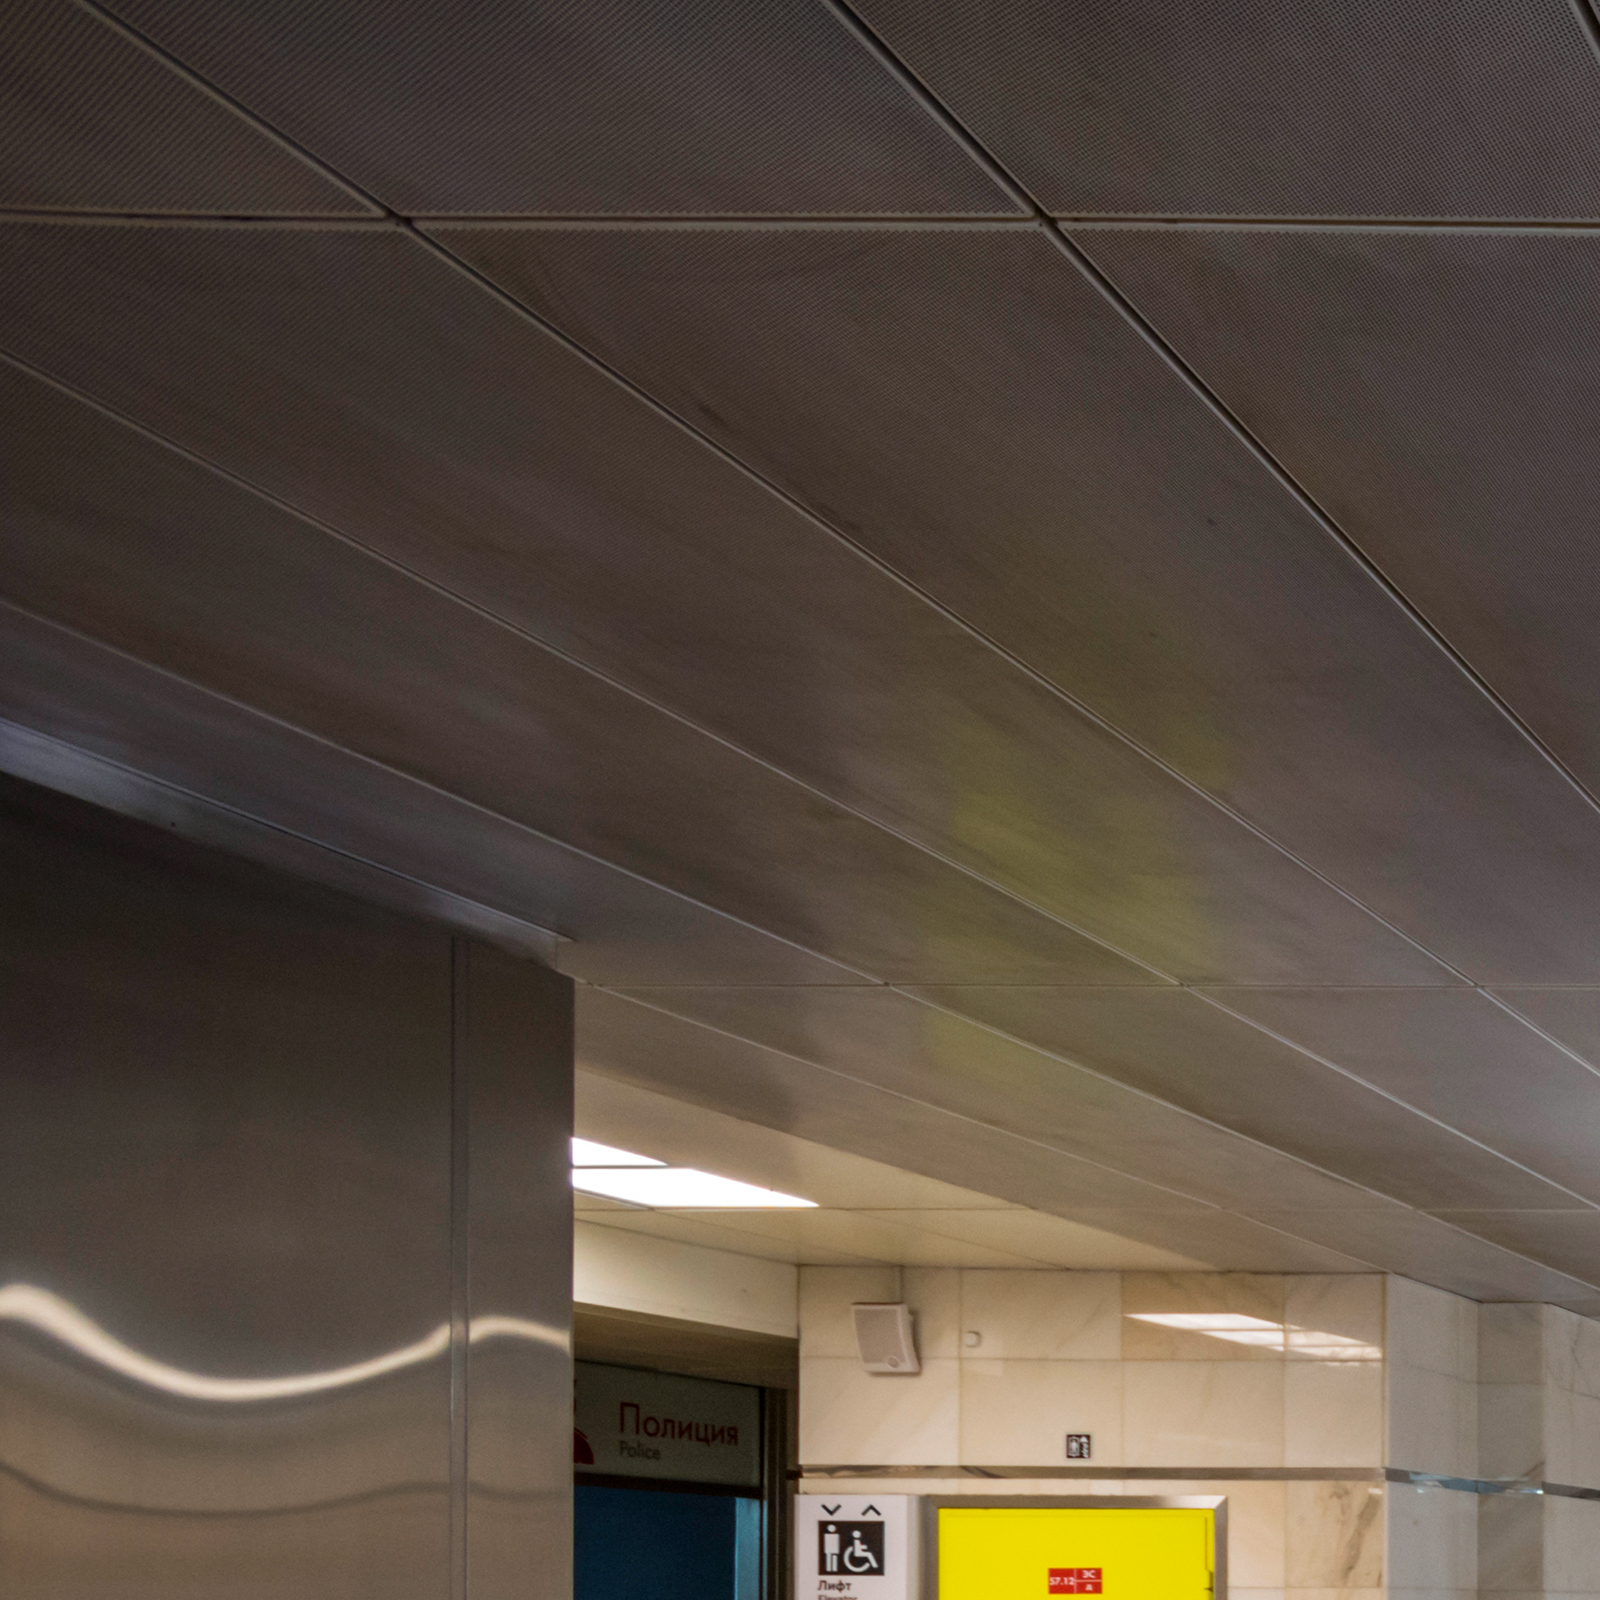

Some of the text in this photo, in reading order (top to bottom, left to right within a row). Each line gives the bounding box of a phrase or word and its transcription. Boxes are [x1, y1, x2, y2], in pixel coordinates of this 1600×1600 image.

[620, 1402, 739, 1446] Полиция
[619, 1440, 661, 1460] Police
[817, 1579, 852, 1593] Лифт
[1049, 1576, 1075, 1586] 57.12
